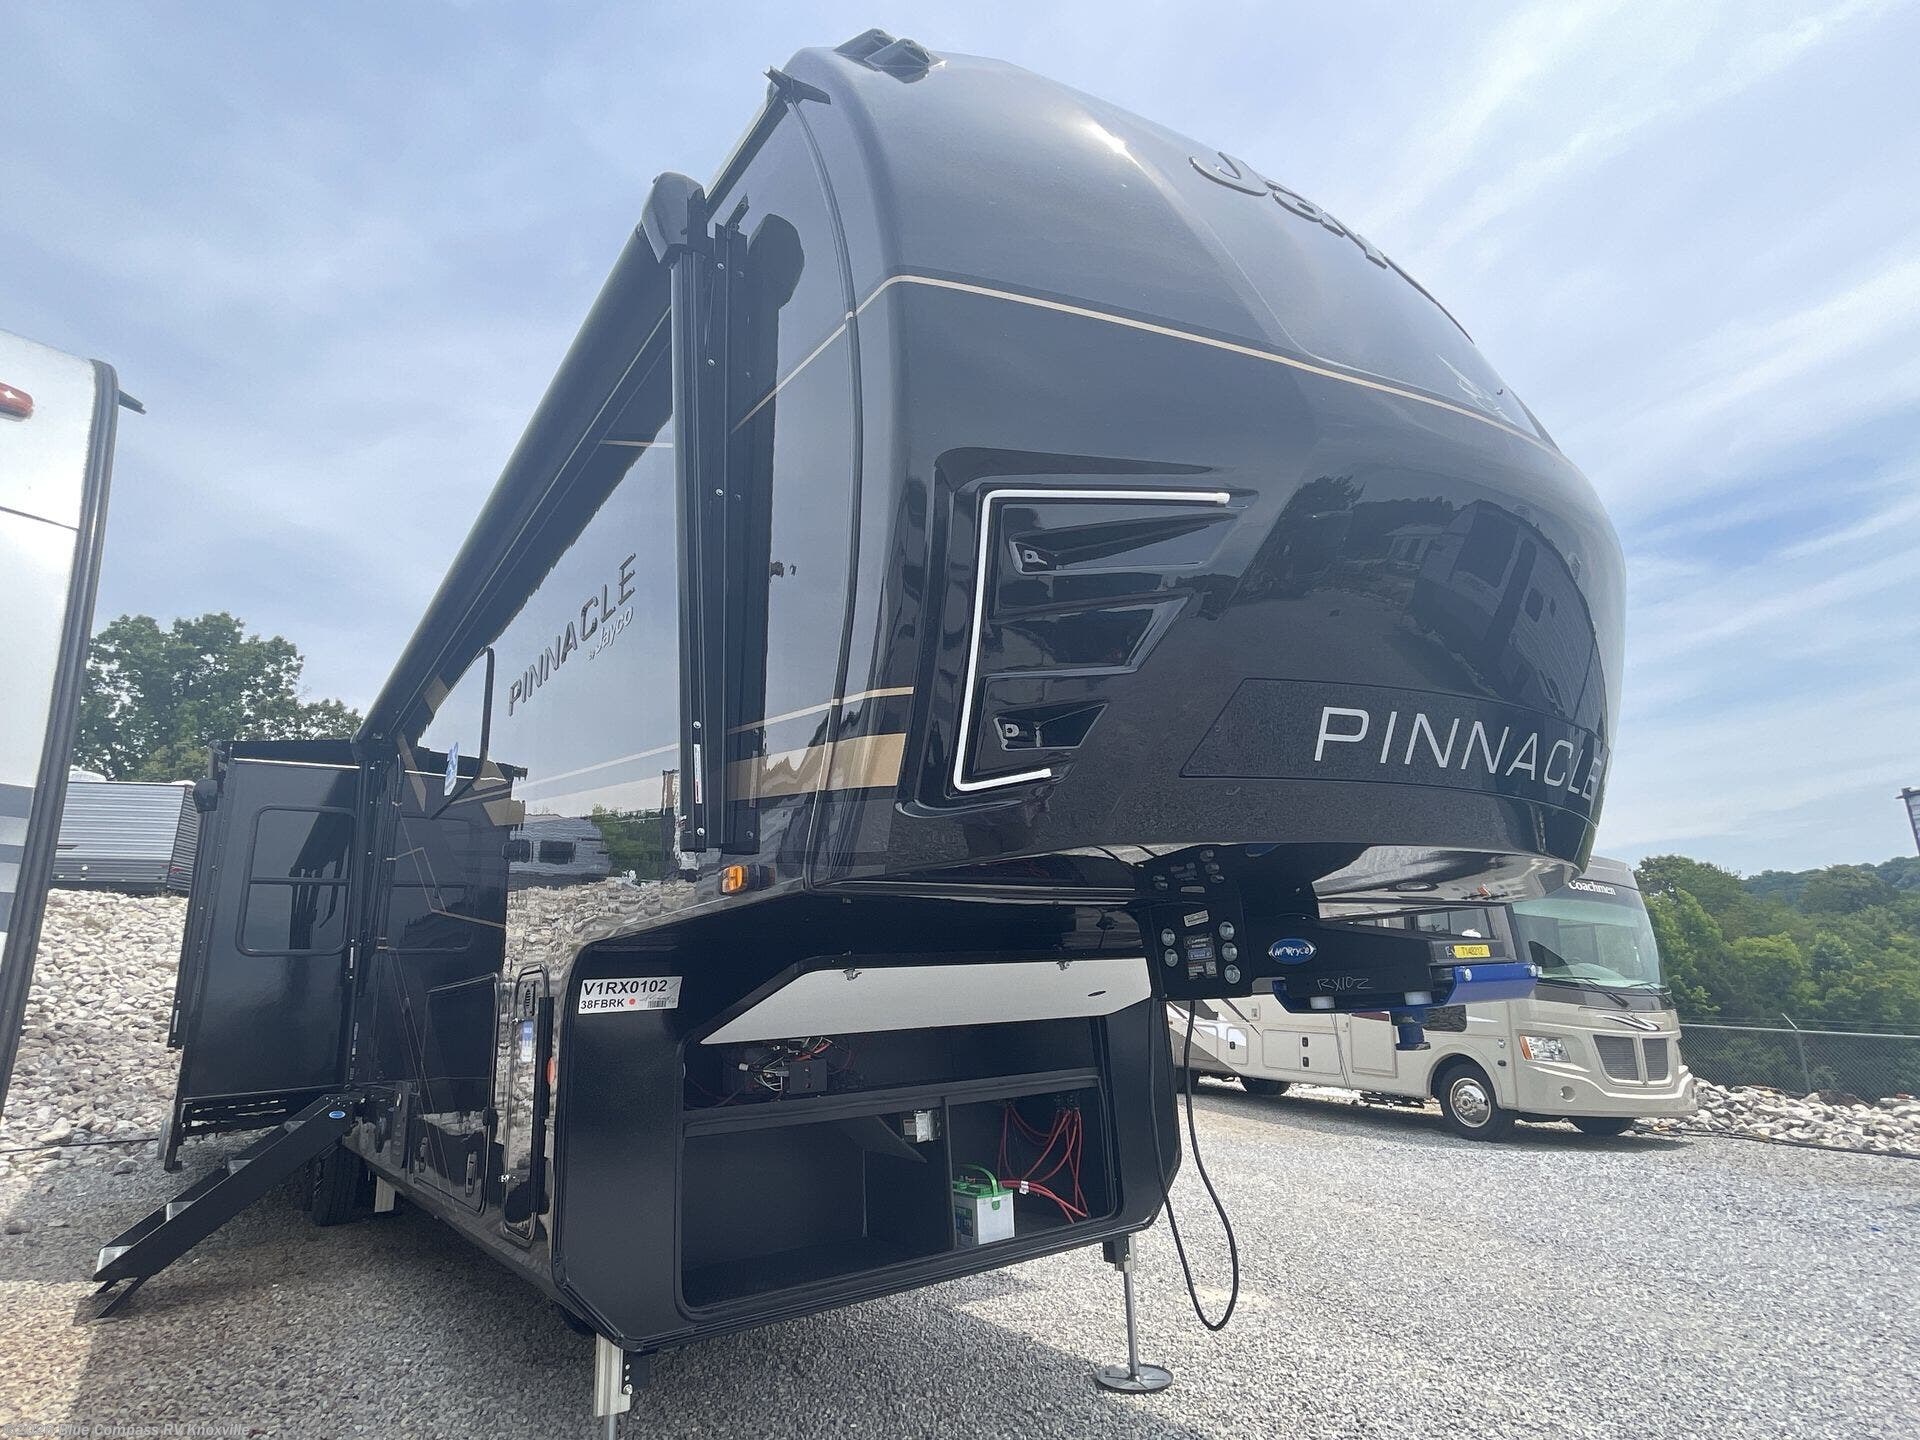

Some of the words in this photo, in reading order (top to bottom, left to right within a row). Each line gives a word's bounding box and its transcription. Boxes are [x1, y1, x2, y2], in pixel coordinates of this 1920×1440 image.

[509, 552, 636, 717] PINNACLE
[1314, 706, 1602, 800] PINNACLE
[1568, 879, 1617, 896] Coachmen
[583, 980, 668, 996] V1RX0102
[580, 998, 625, 1010] 38FBRK
